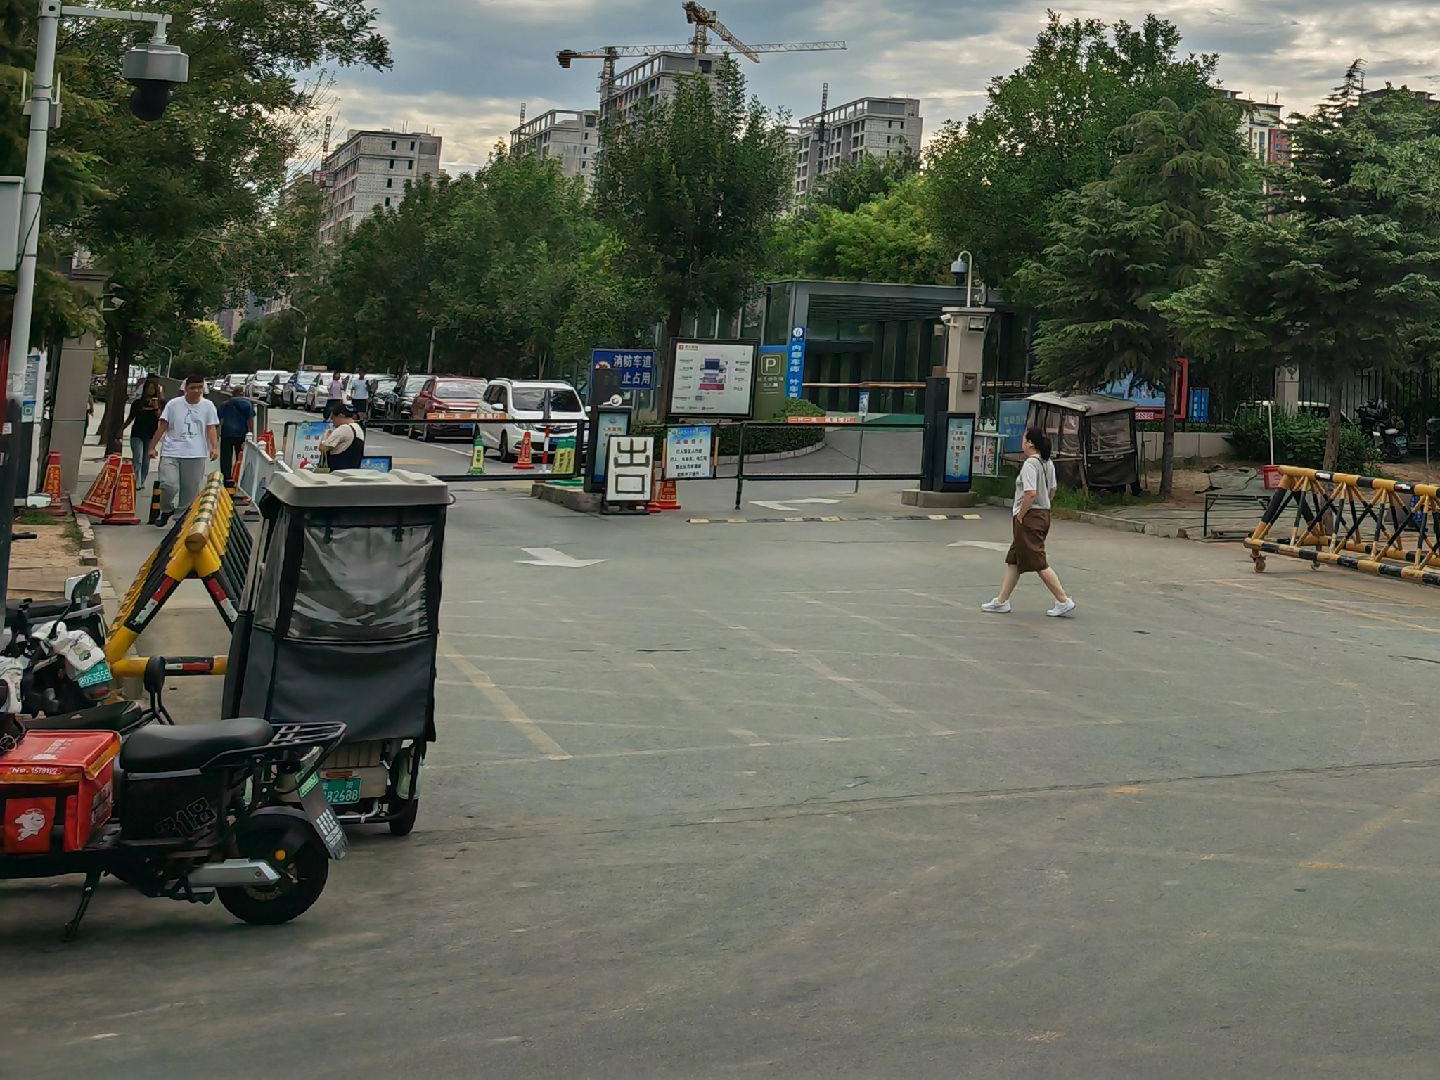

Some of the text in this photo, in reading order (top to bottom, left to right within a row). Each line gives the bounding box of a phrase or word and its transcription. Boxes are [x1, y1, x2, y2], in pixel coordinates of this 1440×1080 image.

[613, 354, 652, 369] 消防车道
[621, 371, 651, 385] 止占用
[613, 437, 651, 495] 出口
